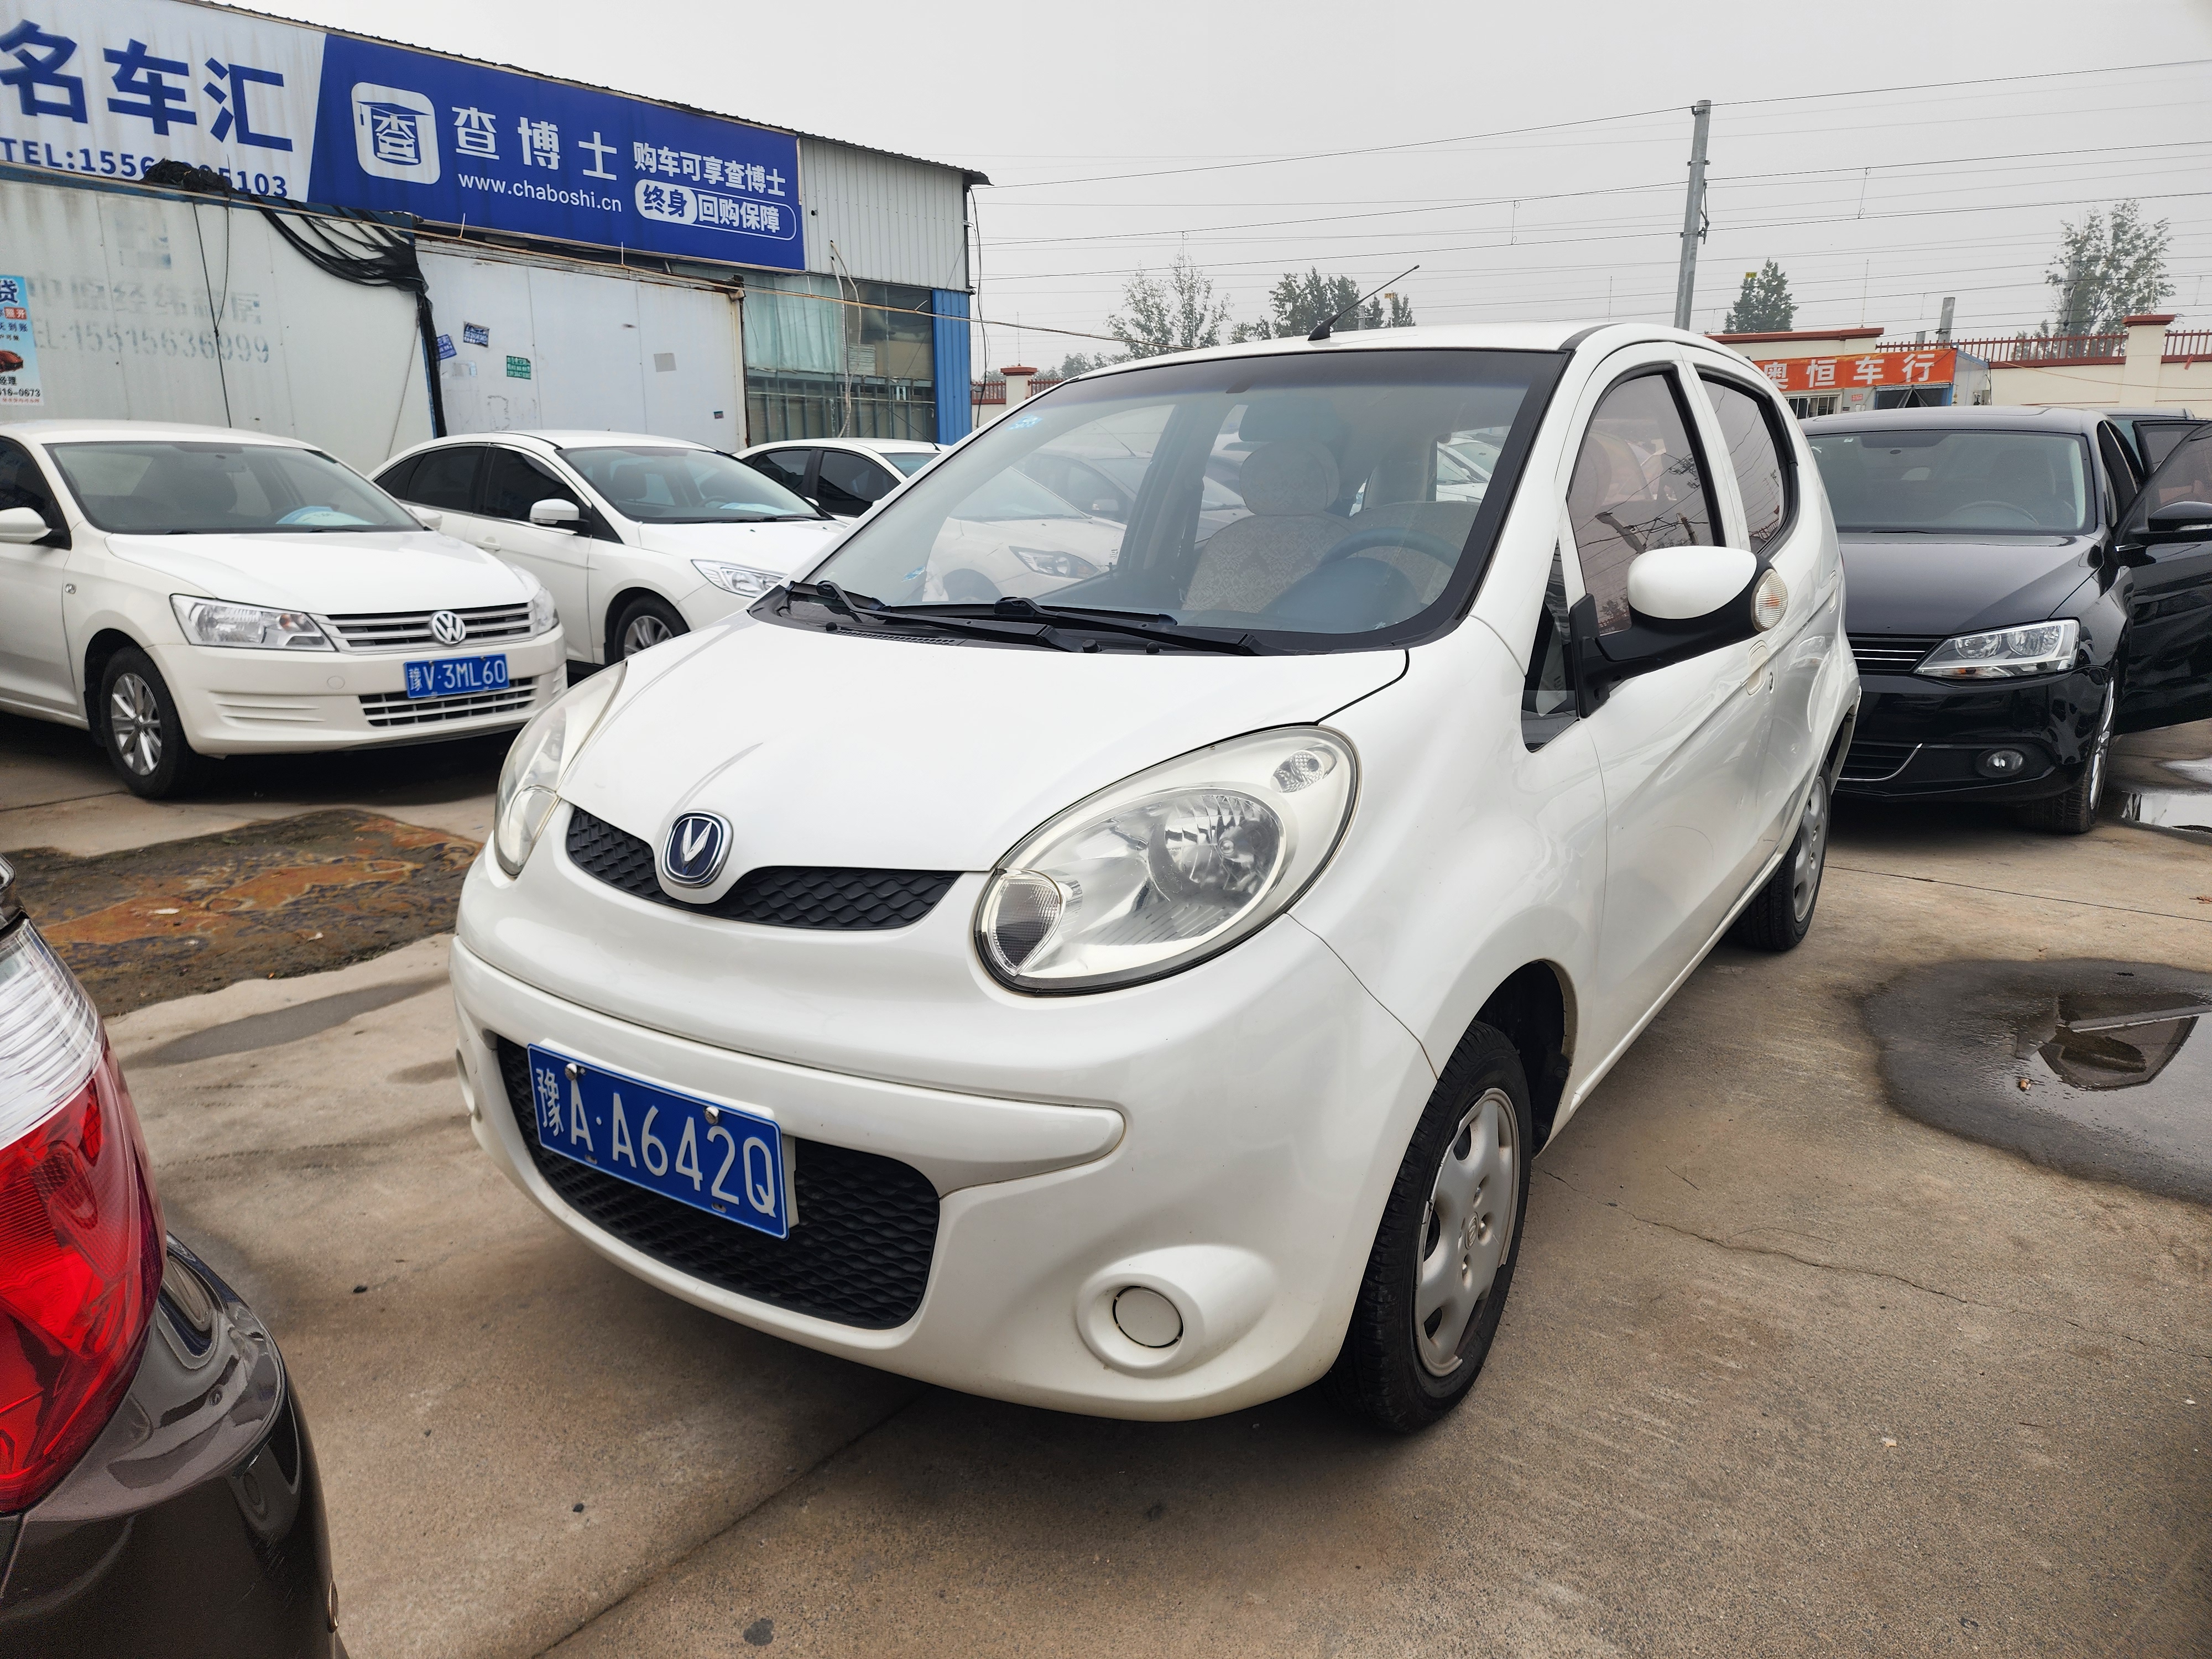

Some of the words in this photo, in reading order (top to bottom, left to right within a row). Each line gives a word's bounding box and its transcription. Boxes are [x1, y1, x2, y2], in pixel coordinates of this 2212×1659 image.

[0, 19, 293, 152] 名车汇
[1, 137, 288, 198] TEL:15565103
[451, 106, 618, 181] 查博士
[633, 141, 786, 197] 购车可享查博士
[457, 173, 622, 213] www.chaboshi.cn
[1764, 353, 1935, 389] 奥恒车行
[535, 1067, 776, 1218] 豫A·A642Q
